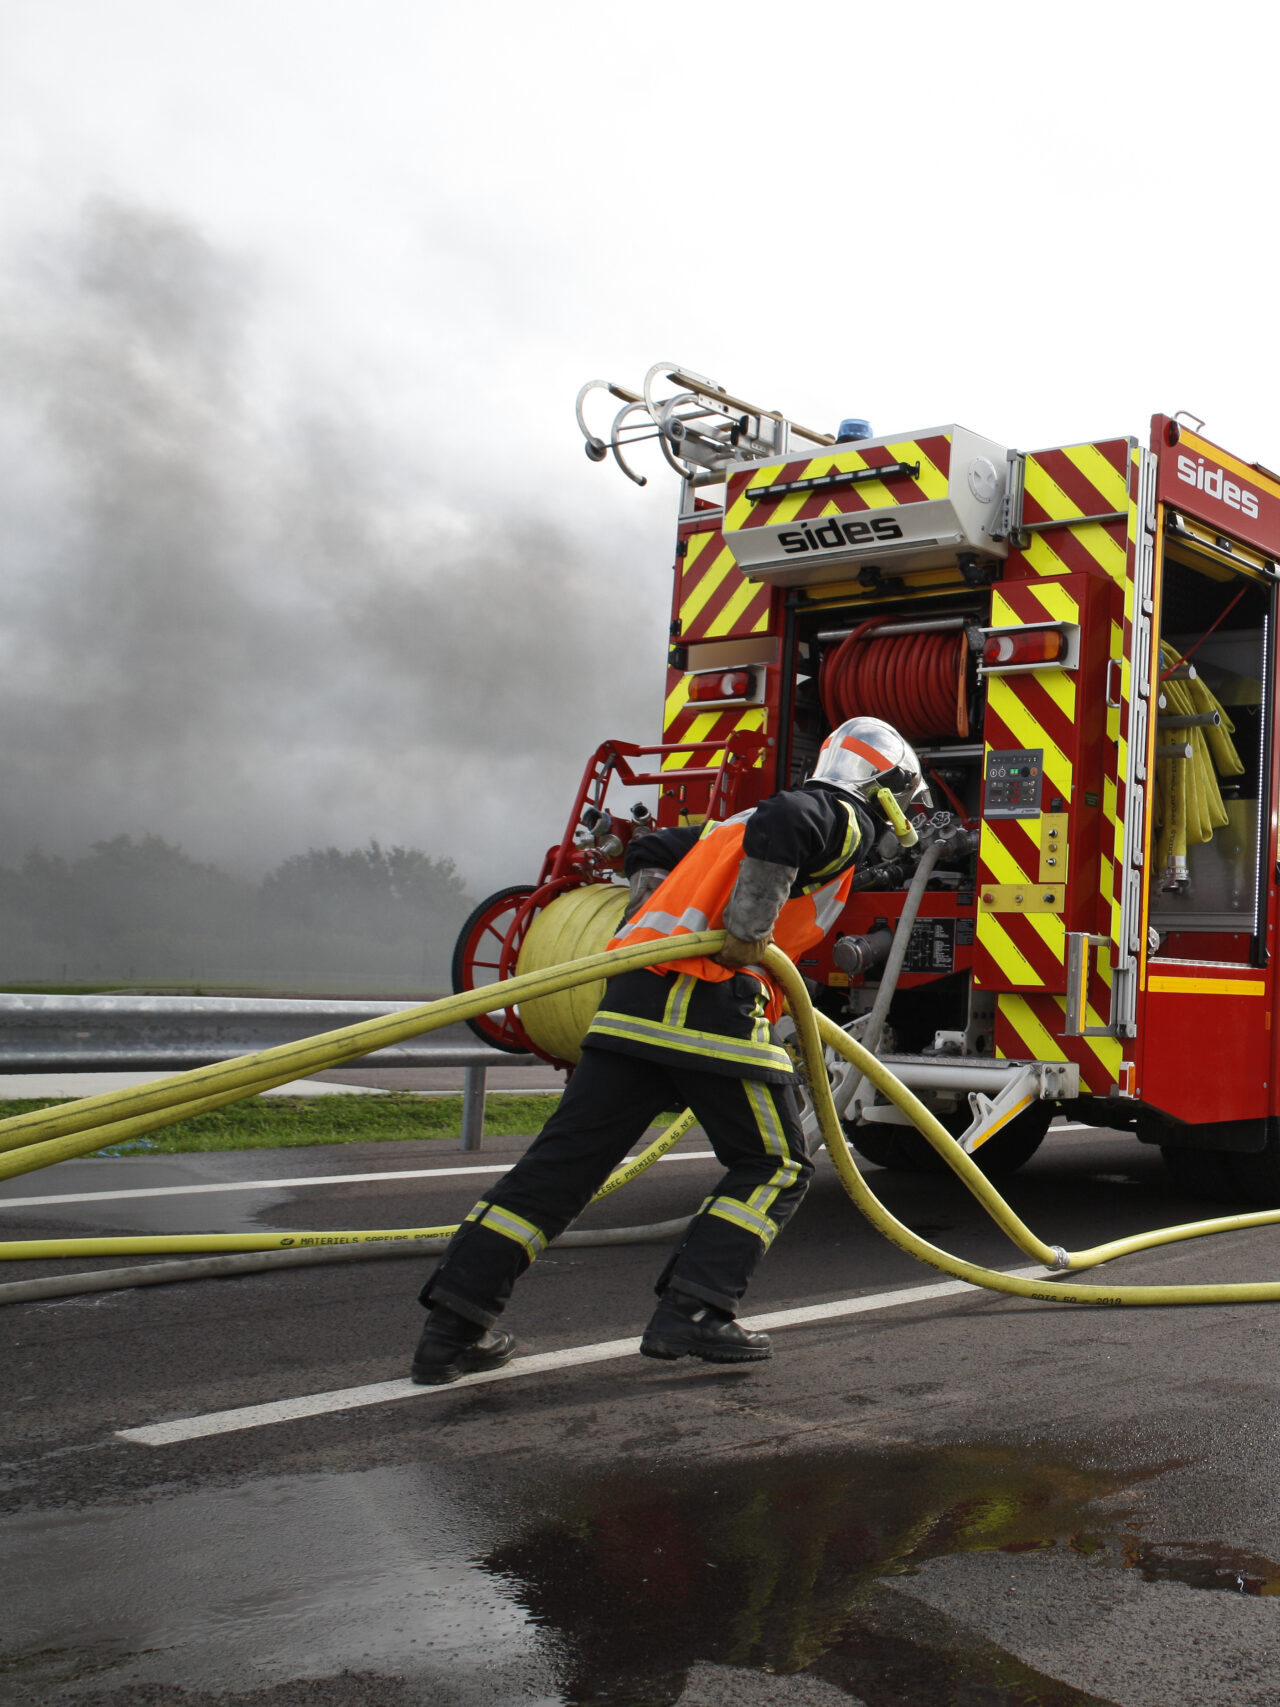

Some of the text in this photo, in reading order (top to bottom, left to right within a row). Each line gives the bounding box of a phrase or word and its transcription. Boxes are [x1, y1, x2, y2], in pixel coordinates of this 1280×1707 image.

[1177, 454, 1259, 519] sides
[777, 518, 903, 553] sides
[624, 1151, 657, 1180] PREMIER
[301, 1236, 359, 1246] MATERIELS
